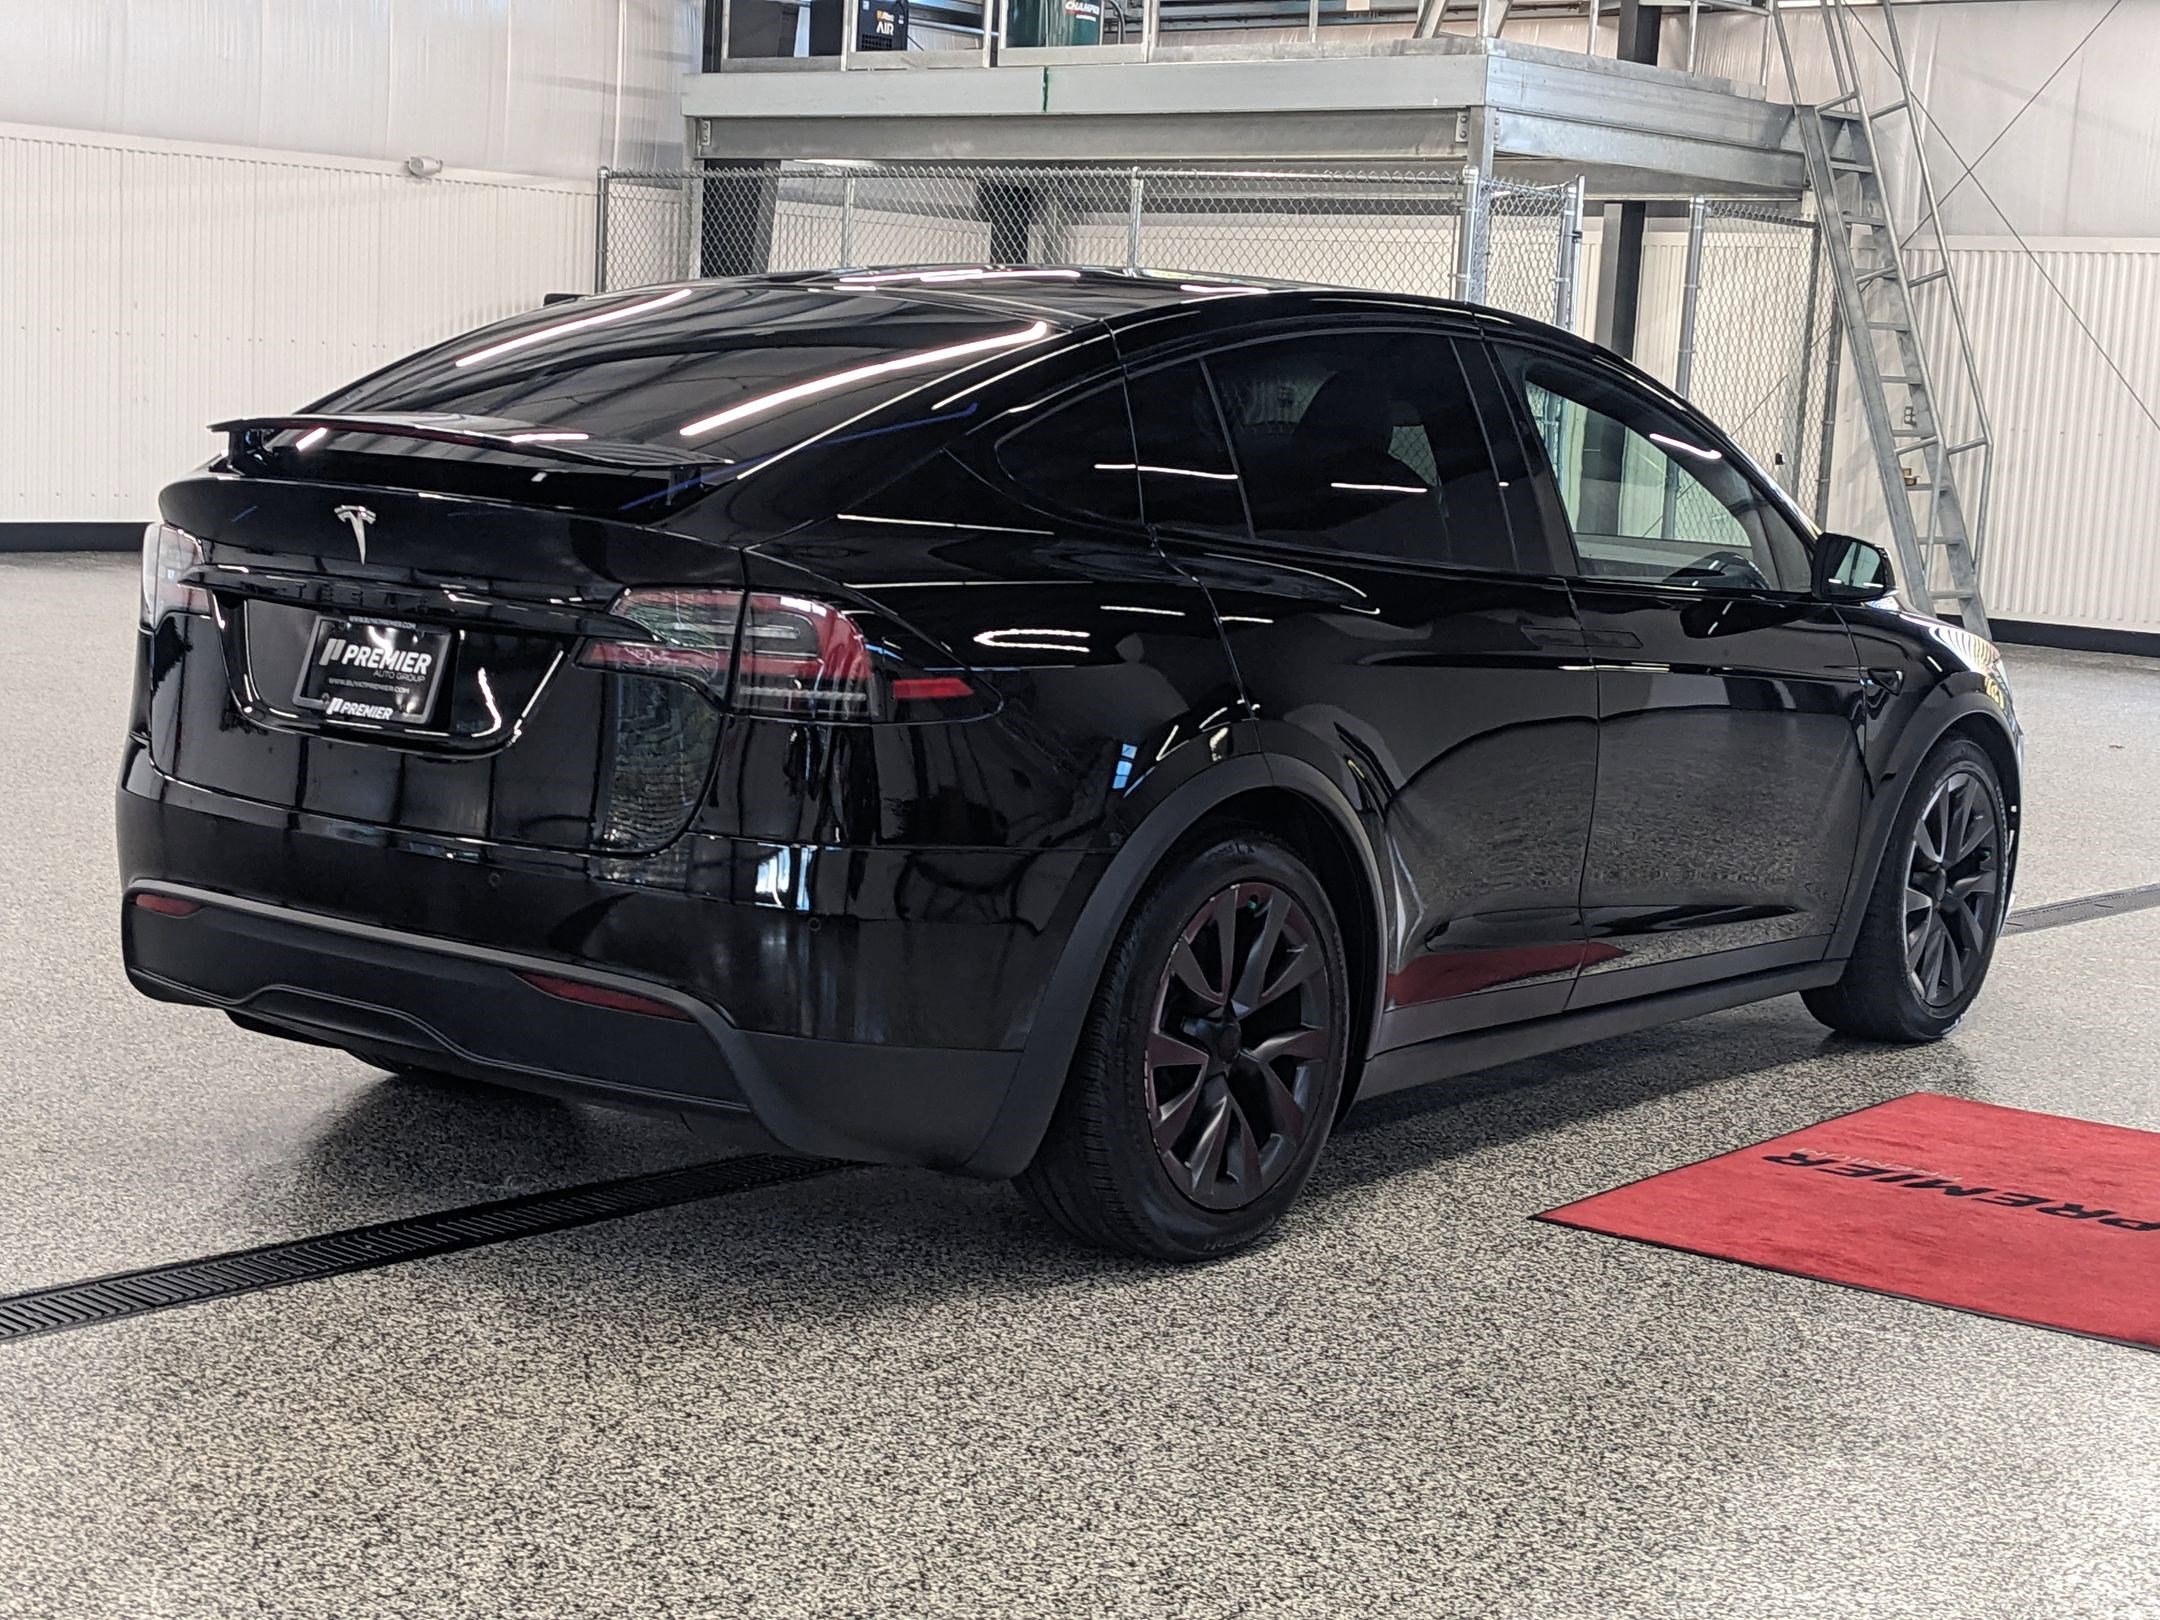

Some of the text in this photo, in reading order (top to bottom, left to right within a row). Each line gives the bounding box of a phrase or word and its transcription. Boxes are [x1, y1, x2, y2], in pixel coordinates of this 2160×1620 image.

[876, 21, 894, 36] AIR
[341, 644, 432, 675] PREMIER
[373, 670, 426, 683] AUTO GROUP
[339, 702, 394, 720] PREMIER
[1762, 1152, 2160, 1231] PREMIER
